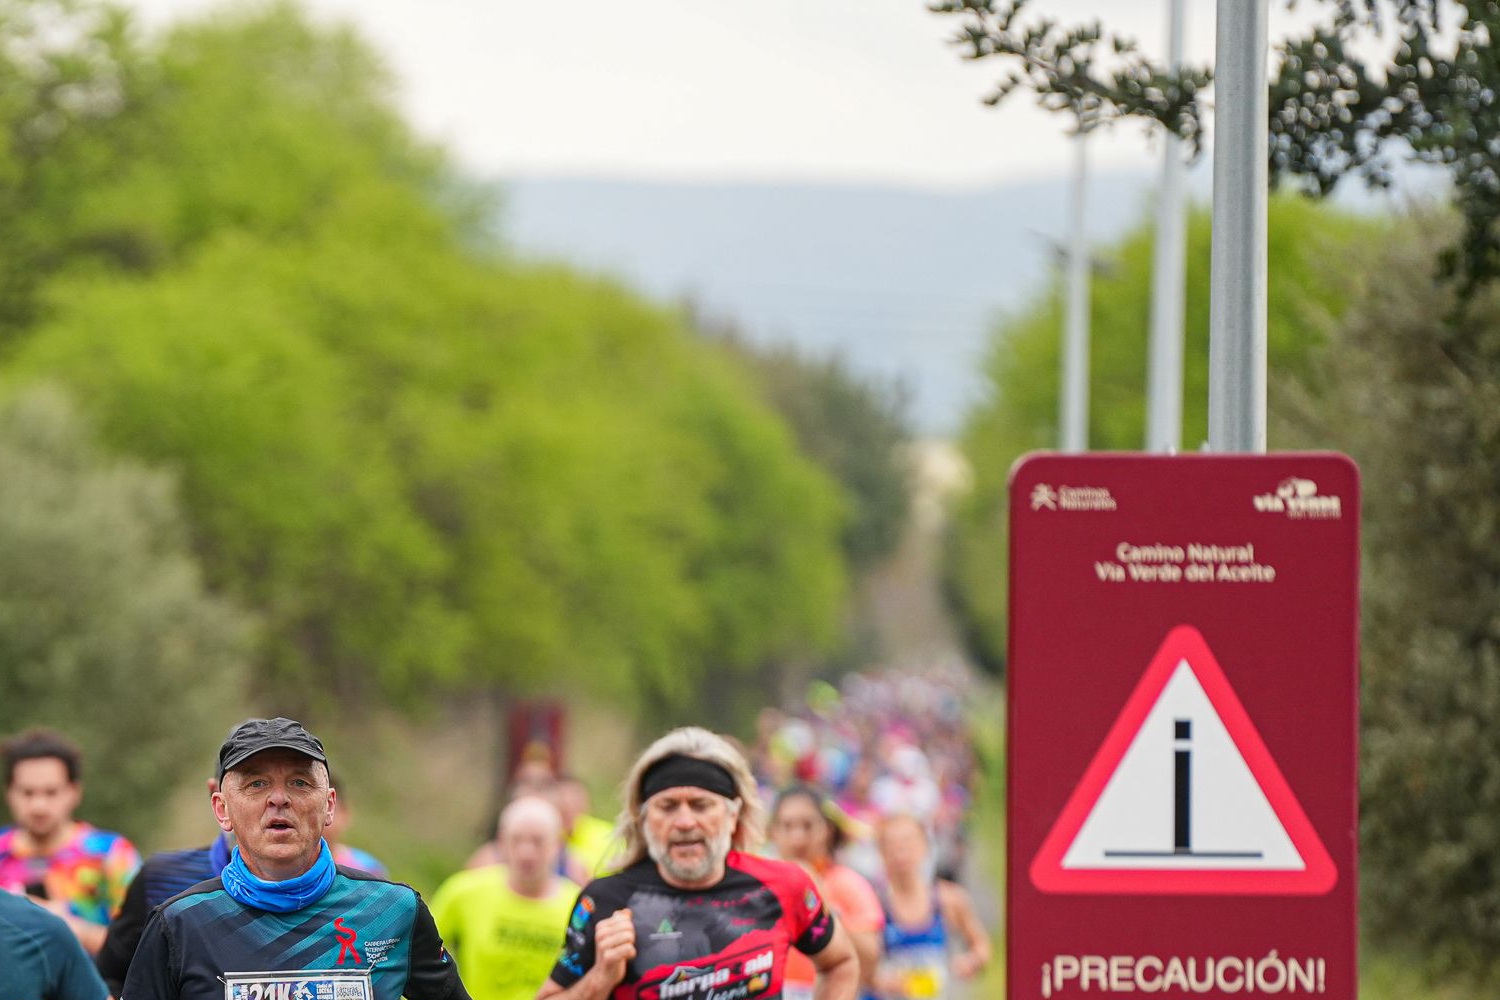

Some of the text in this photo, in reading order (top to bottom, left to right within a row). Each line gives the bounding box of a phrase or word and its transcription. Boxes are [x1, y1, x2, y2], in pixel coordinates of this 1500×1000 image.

[1116, 541, 1254, 564] Camino Natural
[1127, 562, 1182, 582] Verde
[1184, 562, 1215, 582] del
[1216, 562, 1276, 583] Aceite
[1041, 949, 1326, 999] ¡PRECAUCIÓN!
